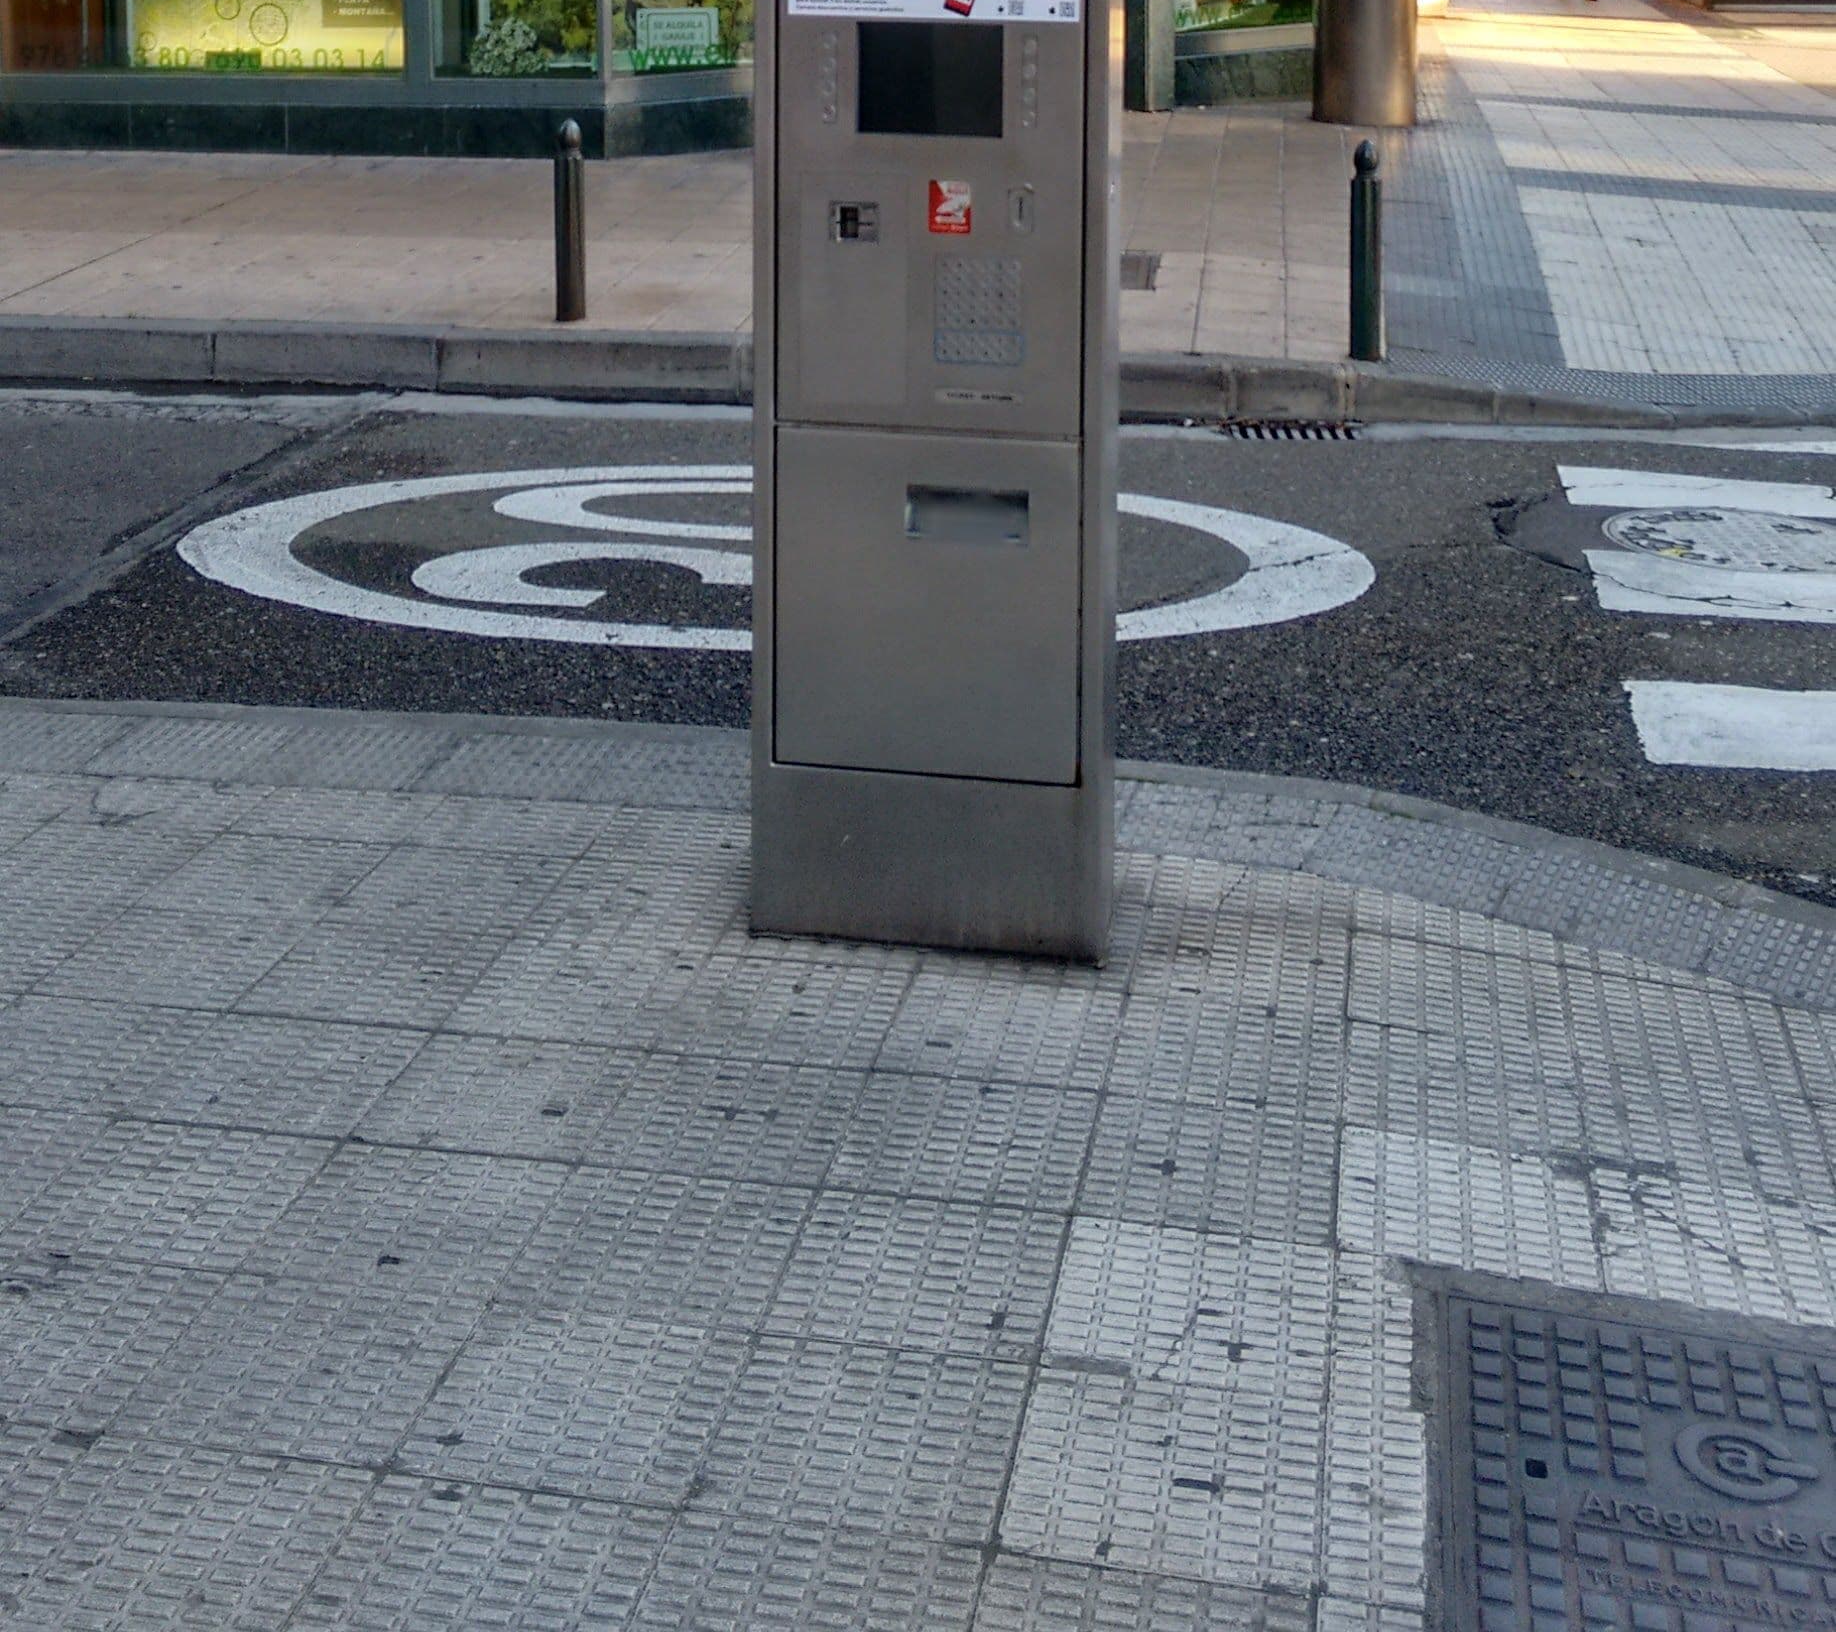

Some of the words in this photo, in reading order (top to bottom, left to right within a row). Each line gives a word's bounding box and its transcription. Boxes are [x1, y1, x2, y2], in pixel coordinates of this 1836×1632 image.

[158, 47, 191, 66] 80
[272, 47, 303, 66] 03
[313, 47, 345, 66] 03
[356, 47, 386, 66] 14
[1753, 1521, 1808, 1553] de
